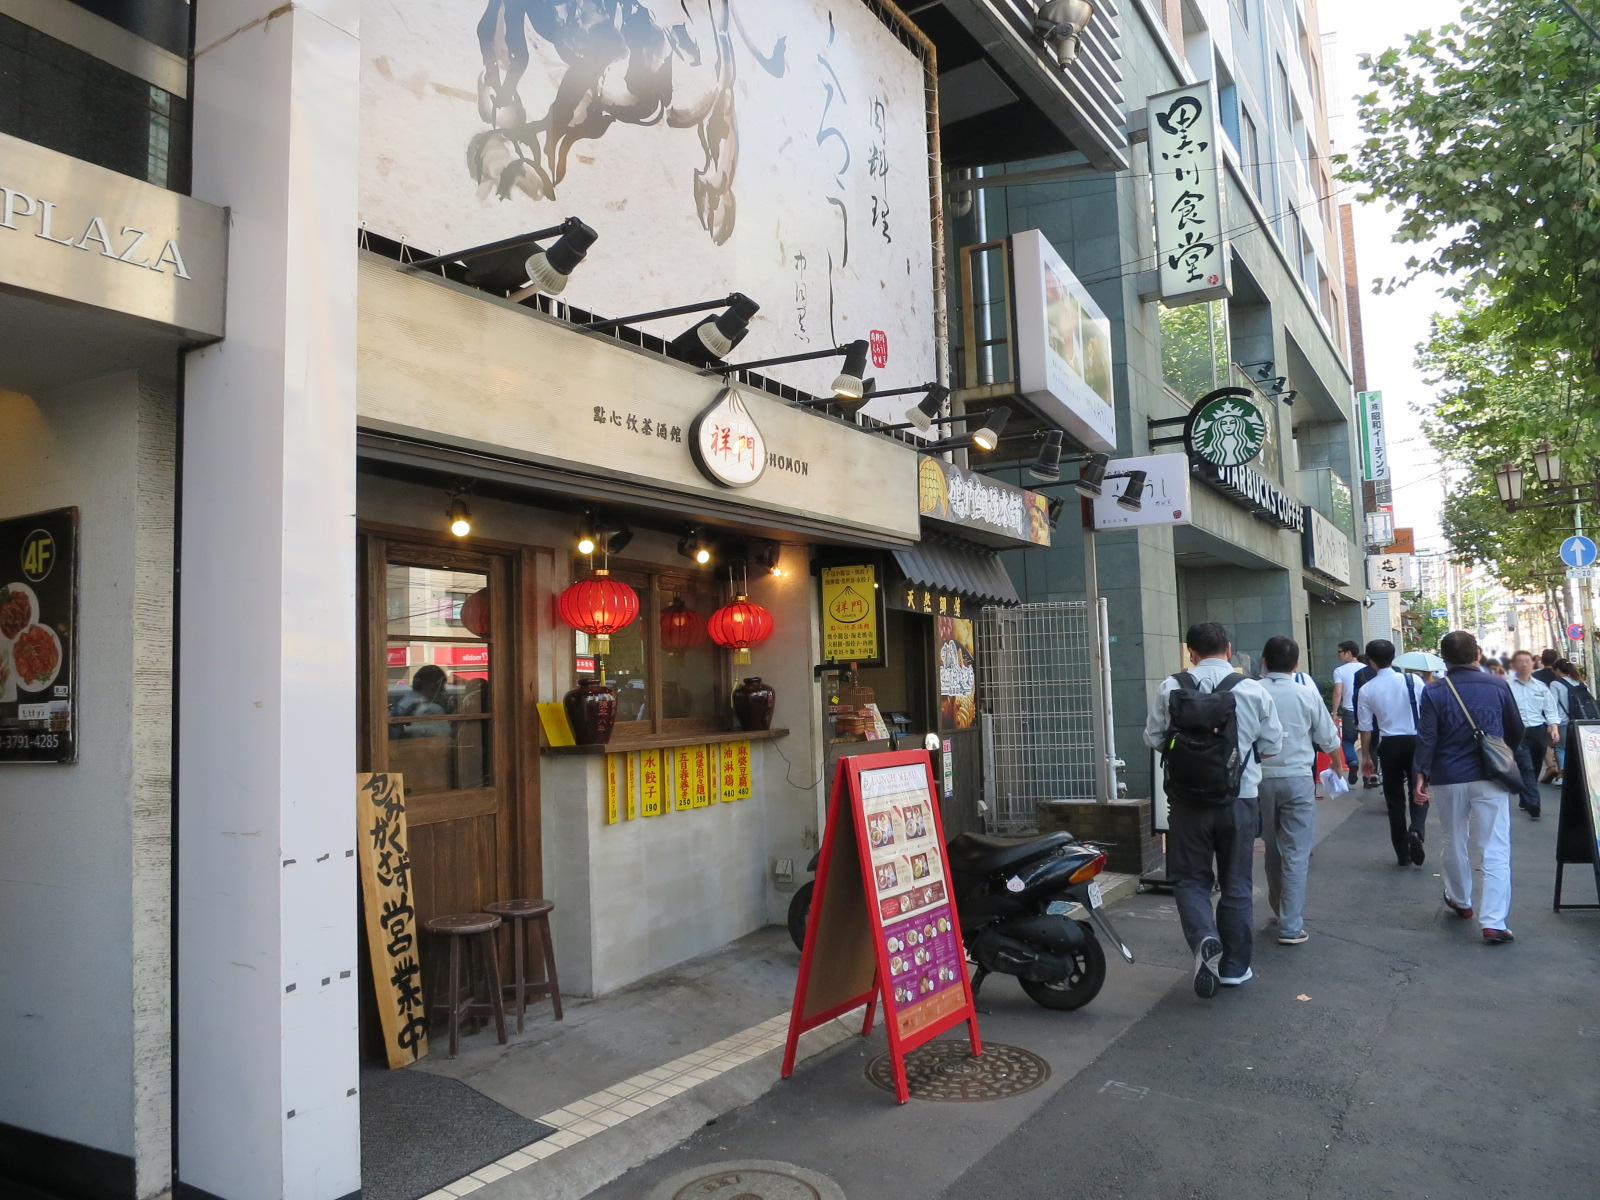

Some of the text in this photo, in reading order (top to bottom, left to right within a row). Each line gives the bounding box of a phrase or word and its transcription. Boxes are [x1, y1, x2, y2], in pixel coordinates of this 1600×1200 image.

[867, 95, 892, 244] 肉料理
[1155, 96, 1214, 283] 黒川食堂
[0, 187, 192, 280] PLAZA
[710, 424, 756, 471] 祥門
[1278, 490, 1304, 533] COFFEE
[25, 539, 51, 574] 4F
[836, 600, 862, 613] 祥門
[644, 755, 657, 799] 水餃子
[723, 747, 735, 788] 油淋鶏
[737, 745, 748, 788] 麻婆豆腐
[871, 772, 896, 786] LUNCH
[898, 769, 917, 781] MENU
[645, 803, 658, 812] 190
[679, 798, 691, 806] 250
[723, 789, 735, 798] 480
[738, 787, 750, 796] 480
